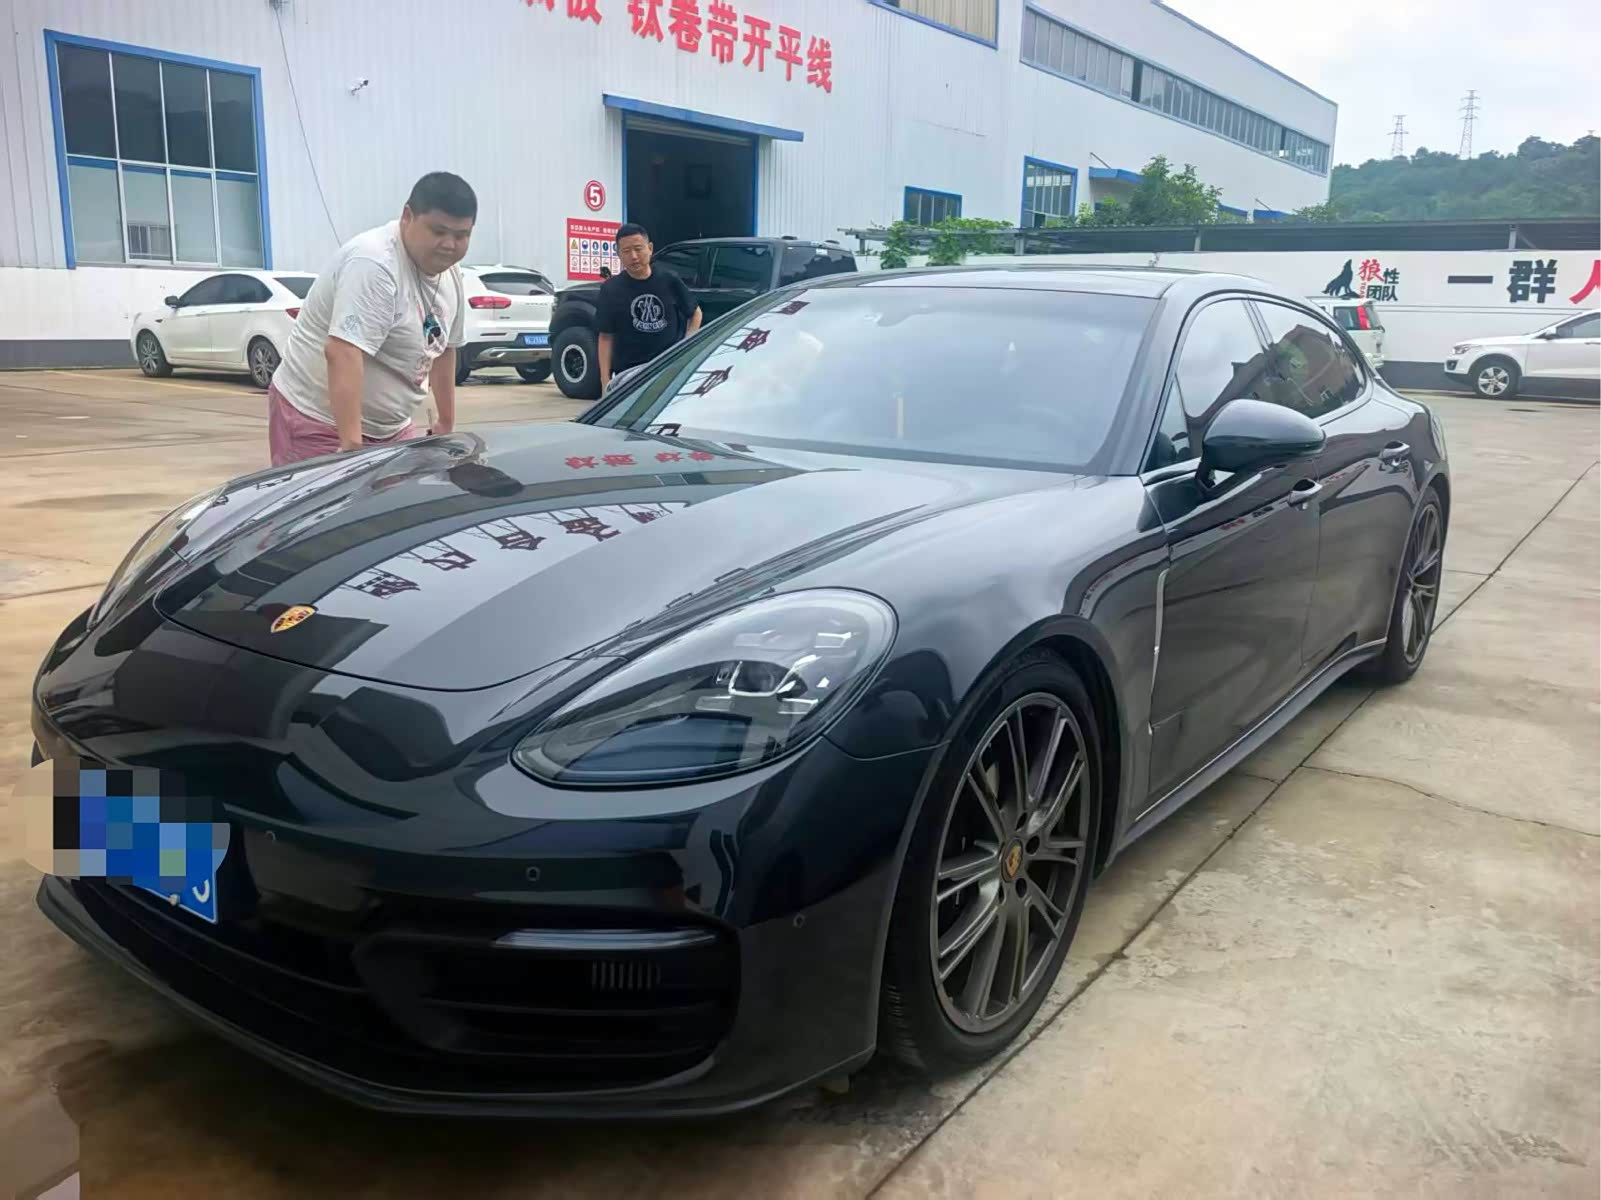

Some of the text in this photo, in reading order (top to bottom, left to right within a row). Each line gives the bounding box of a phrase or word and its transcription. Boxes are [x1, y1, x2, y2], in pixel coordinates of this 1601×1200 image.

[589, 185, 601, 206] 5
[1357, 258, 1400, 285] 狼性
[1367, 284, 1398, 301] 团队
